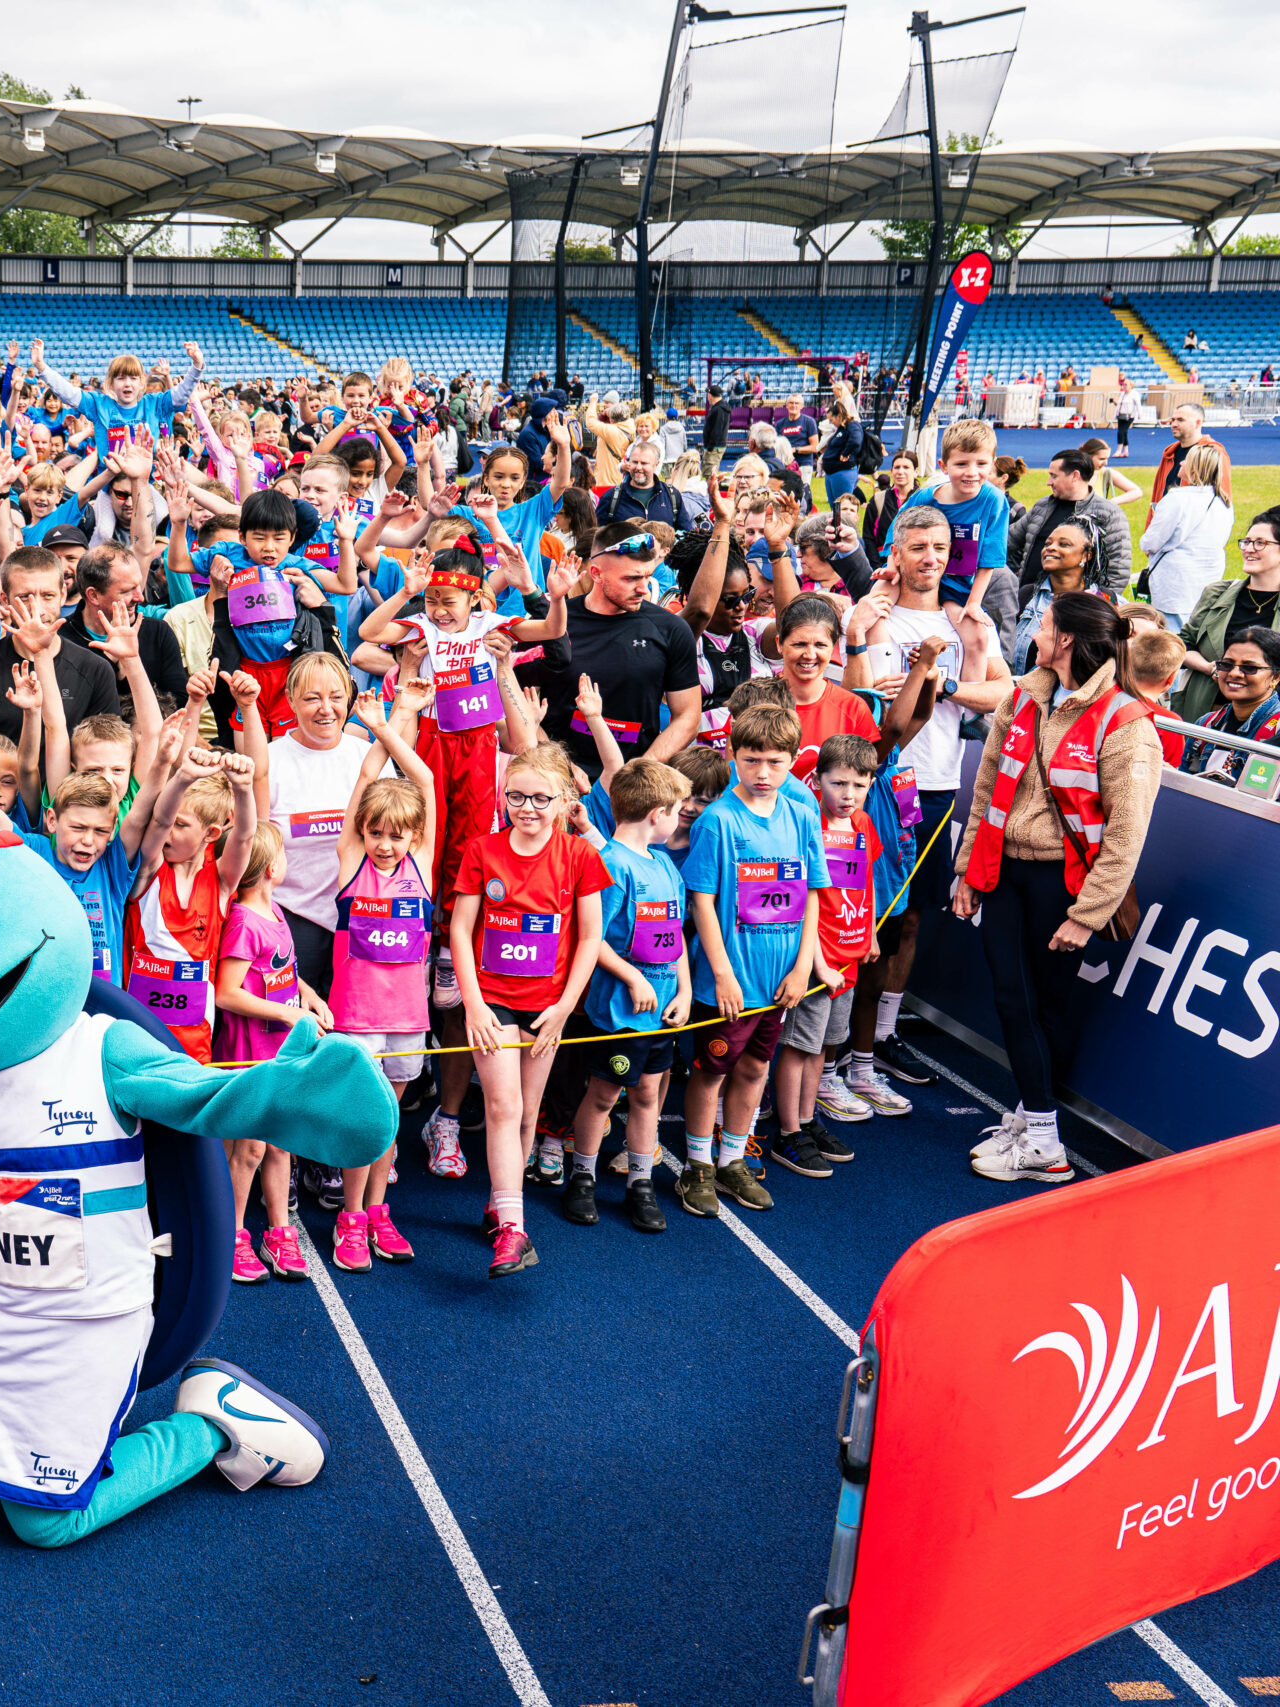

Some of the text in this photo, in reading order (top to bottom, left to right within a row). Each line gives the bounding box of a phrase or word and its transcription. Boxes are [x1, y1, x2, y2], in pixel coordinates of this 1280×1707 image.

[47, 263, 56, 278] L
[387, 268, 402, 283] M
[900, 268, 911, 282] P
[959, 267, 987, 288] X-Z
[928, 340, 952, 394] MEETING
[945, 301, 965, 340] POINT
[244, 592, 279, 609] 349
[443, 673, 468, 685] AJBell
[458, 694, 489, 715] 141
[308, 821, 344, 834] ADUL
[831, 833, 854, 845] AJBell
[751, 867, 775, 878] AJBell
[845, 861, 858, 875] 11
[361, 900, 388, 913] AJBell
[760, 892, 790, 908] 701
[494, 915, 518, 927] AJBell
[367, 930, 408, 947] 464
[653, 931, 675, 948] 733
[500, 943, 537, 961] 201
[144, 962, 170, 975] AJBell
[147, 991, 188, 1010] 238
[1029, 1120, 1056, 1128] adidas
[44, 1186, 63, 1194] AJBell
[1116, 1476, 1199, 1550] Feel
